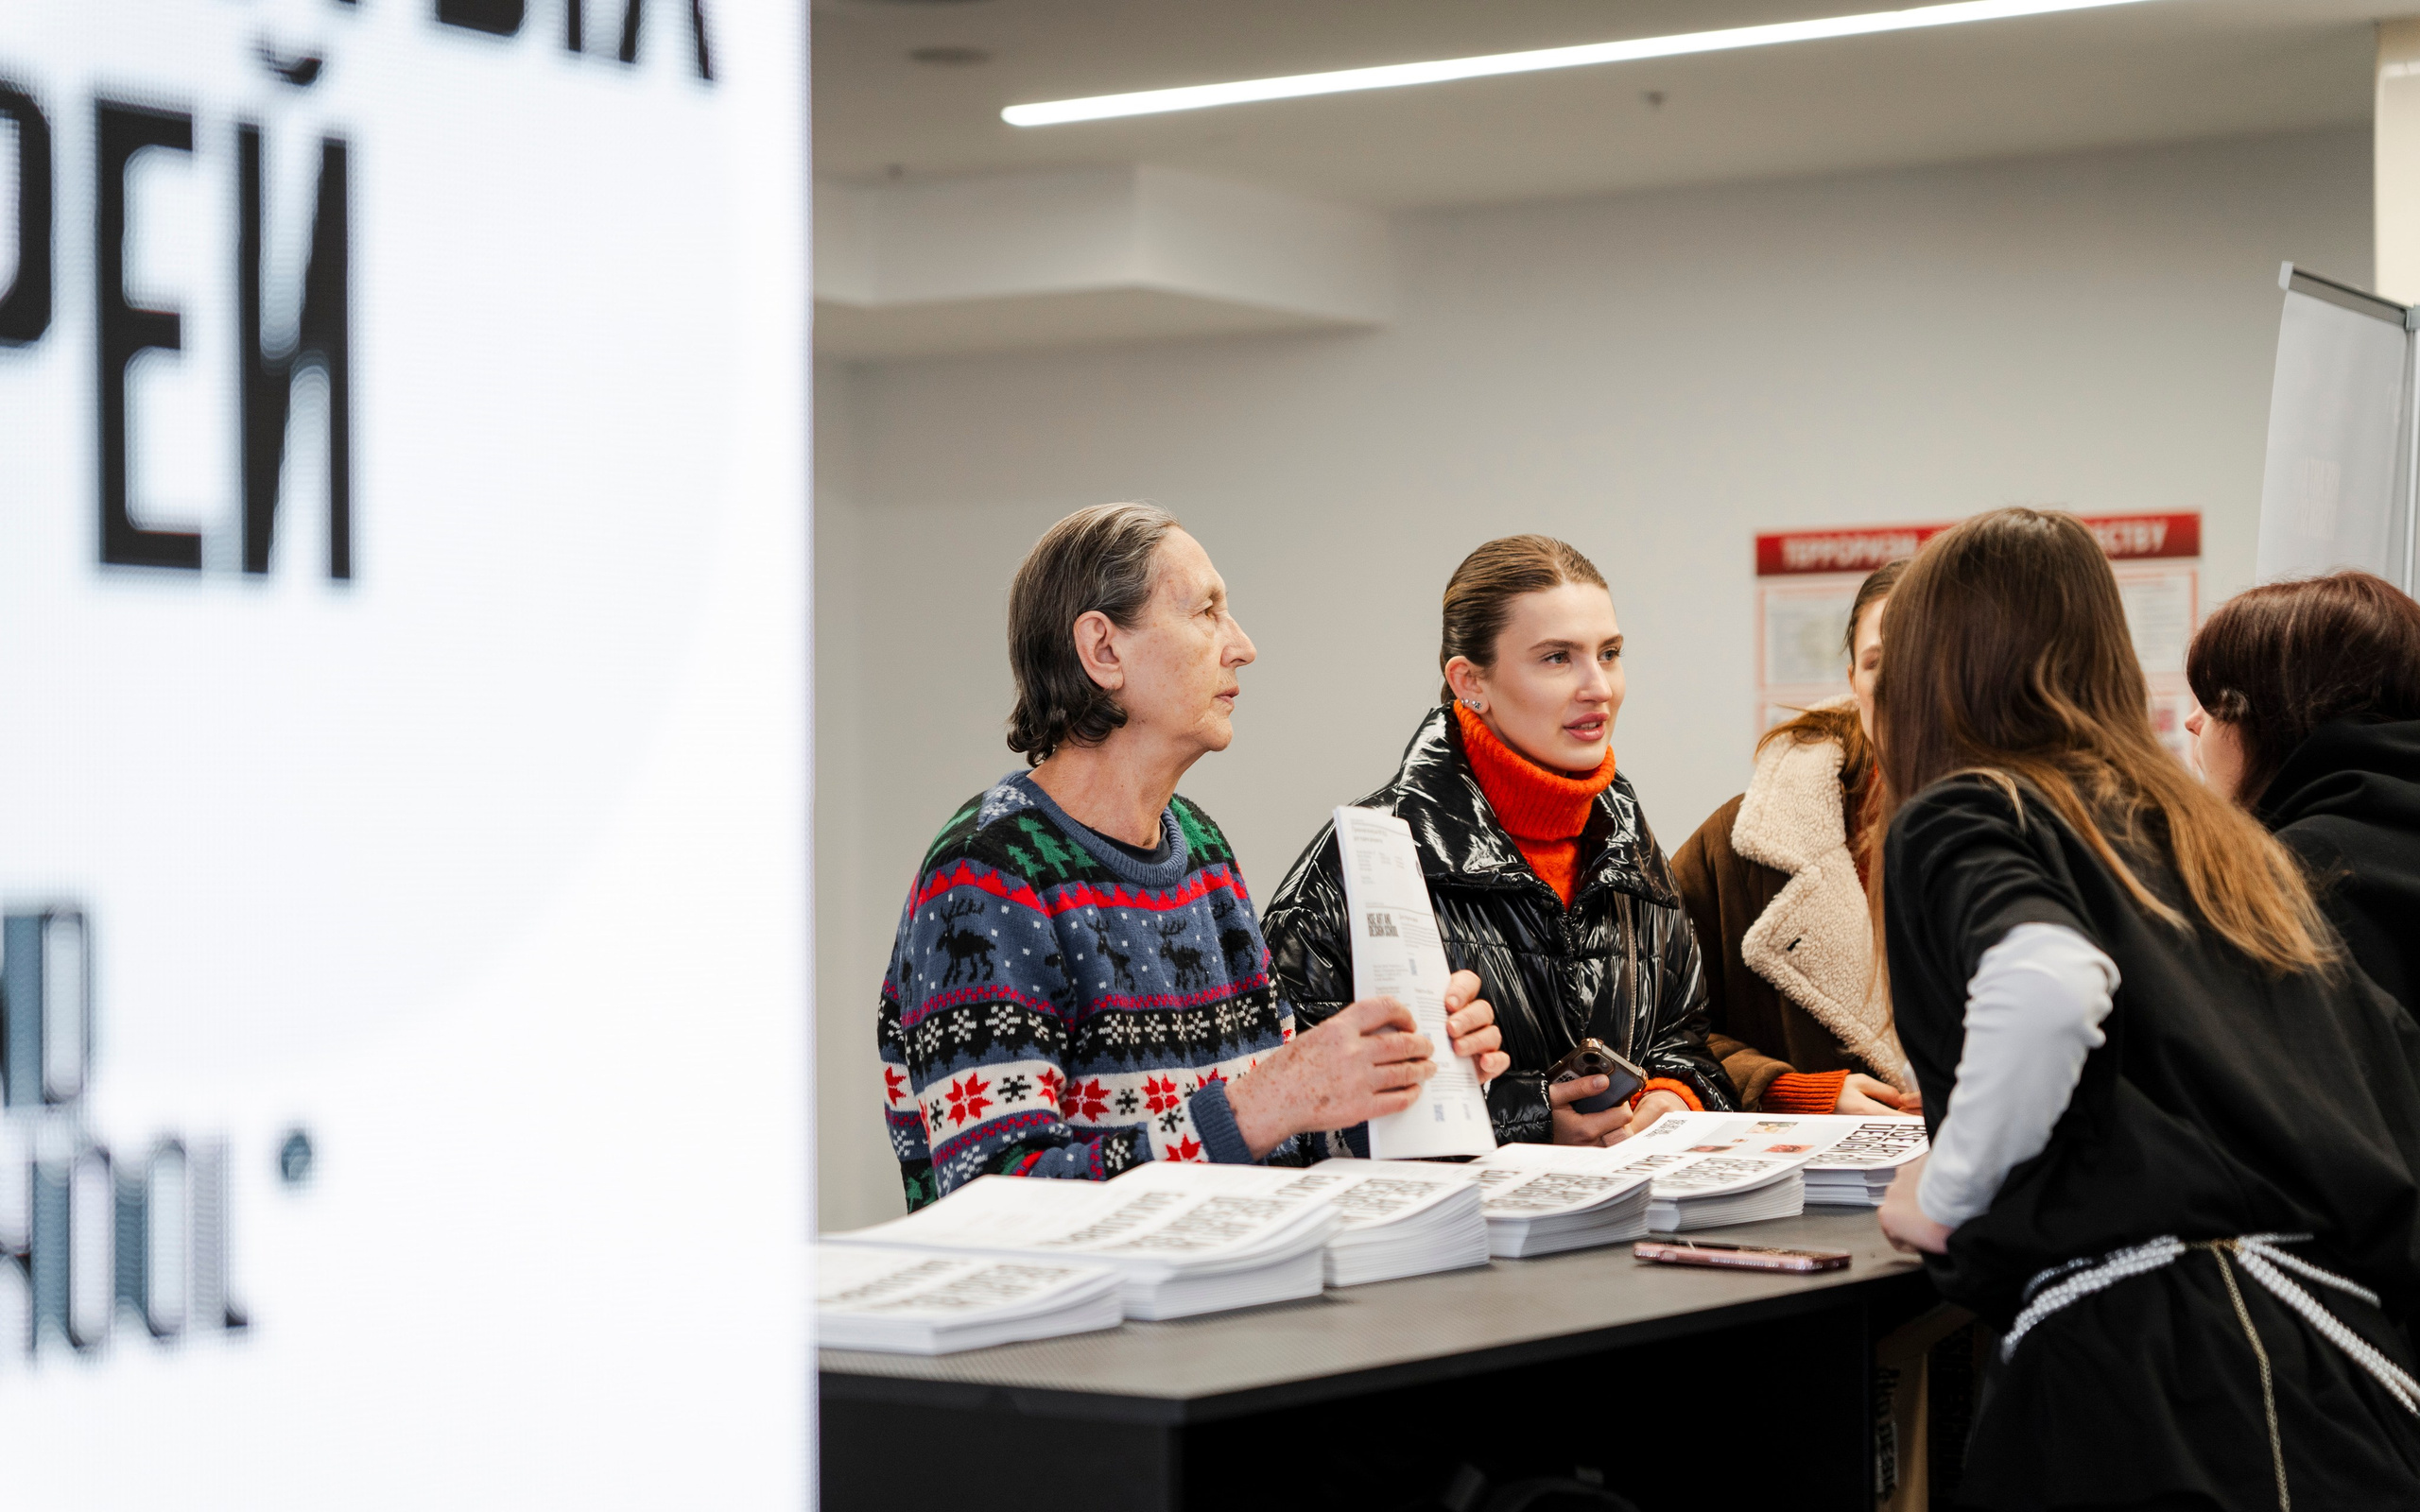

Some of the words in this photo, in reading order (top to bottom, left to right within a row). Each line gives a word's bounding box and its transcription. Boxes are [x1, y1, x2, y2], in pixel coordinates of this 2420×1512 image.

[1367, 914, 1376, 926] HSE
[1368, 925, 1385, 937] DESIGN
[1385, 925, 1399, 937] SCHOOL
[1825, 1124, 1897, 1153] DESIGN
[1882, 1124, 1927, 1144] HSE
[1860, 1143, 1910, 1158] ART
